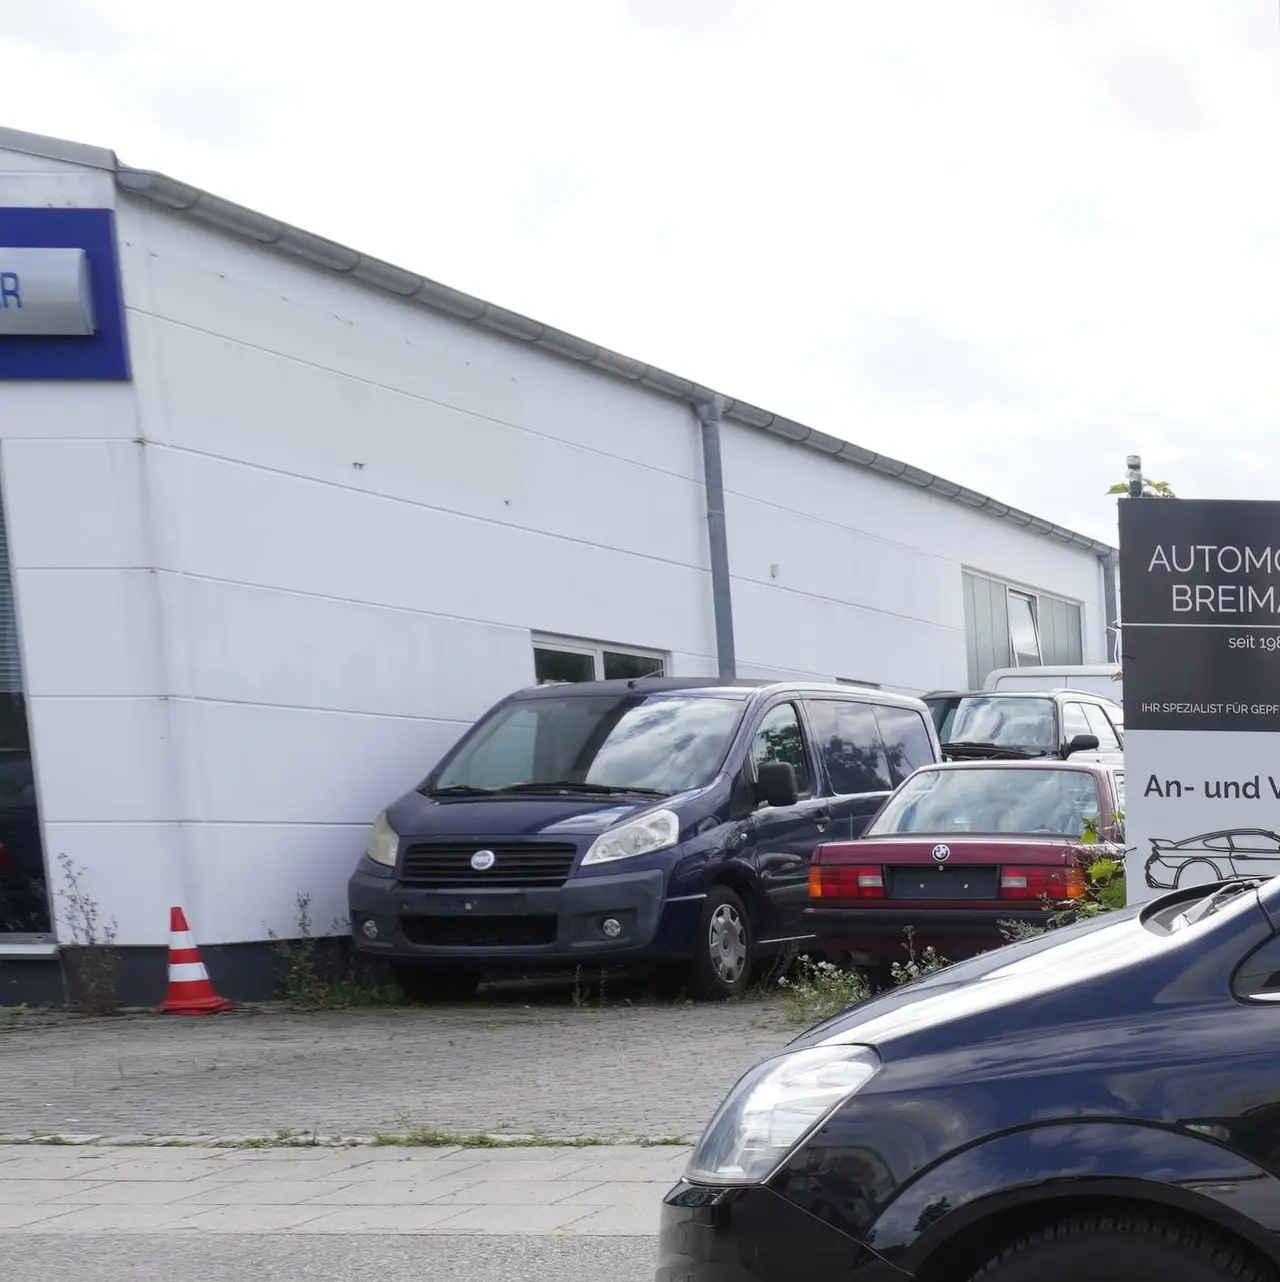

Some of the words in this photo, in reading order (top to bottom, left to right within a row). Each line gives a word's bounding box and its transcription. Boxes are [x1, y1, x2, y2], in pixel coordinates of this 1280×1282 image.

[1228, 635, 1255, 649] seit
[1141, 703, 1160, 713] IHR
[1163, 703, 1223, 714] SPEZIALIST
[1226, 701, 1248, 714] FÜR
[1144, 774, 1195, 798] An-
[1204, 775, 1261, 799] und
